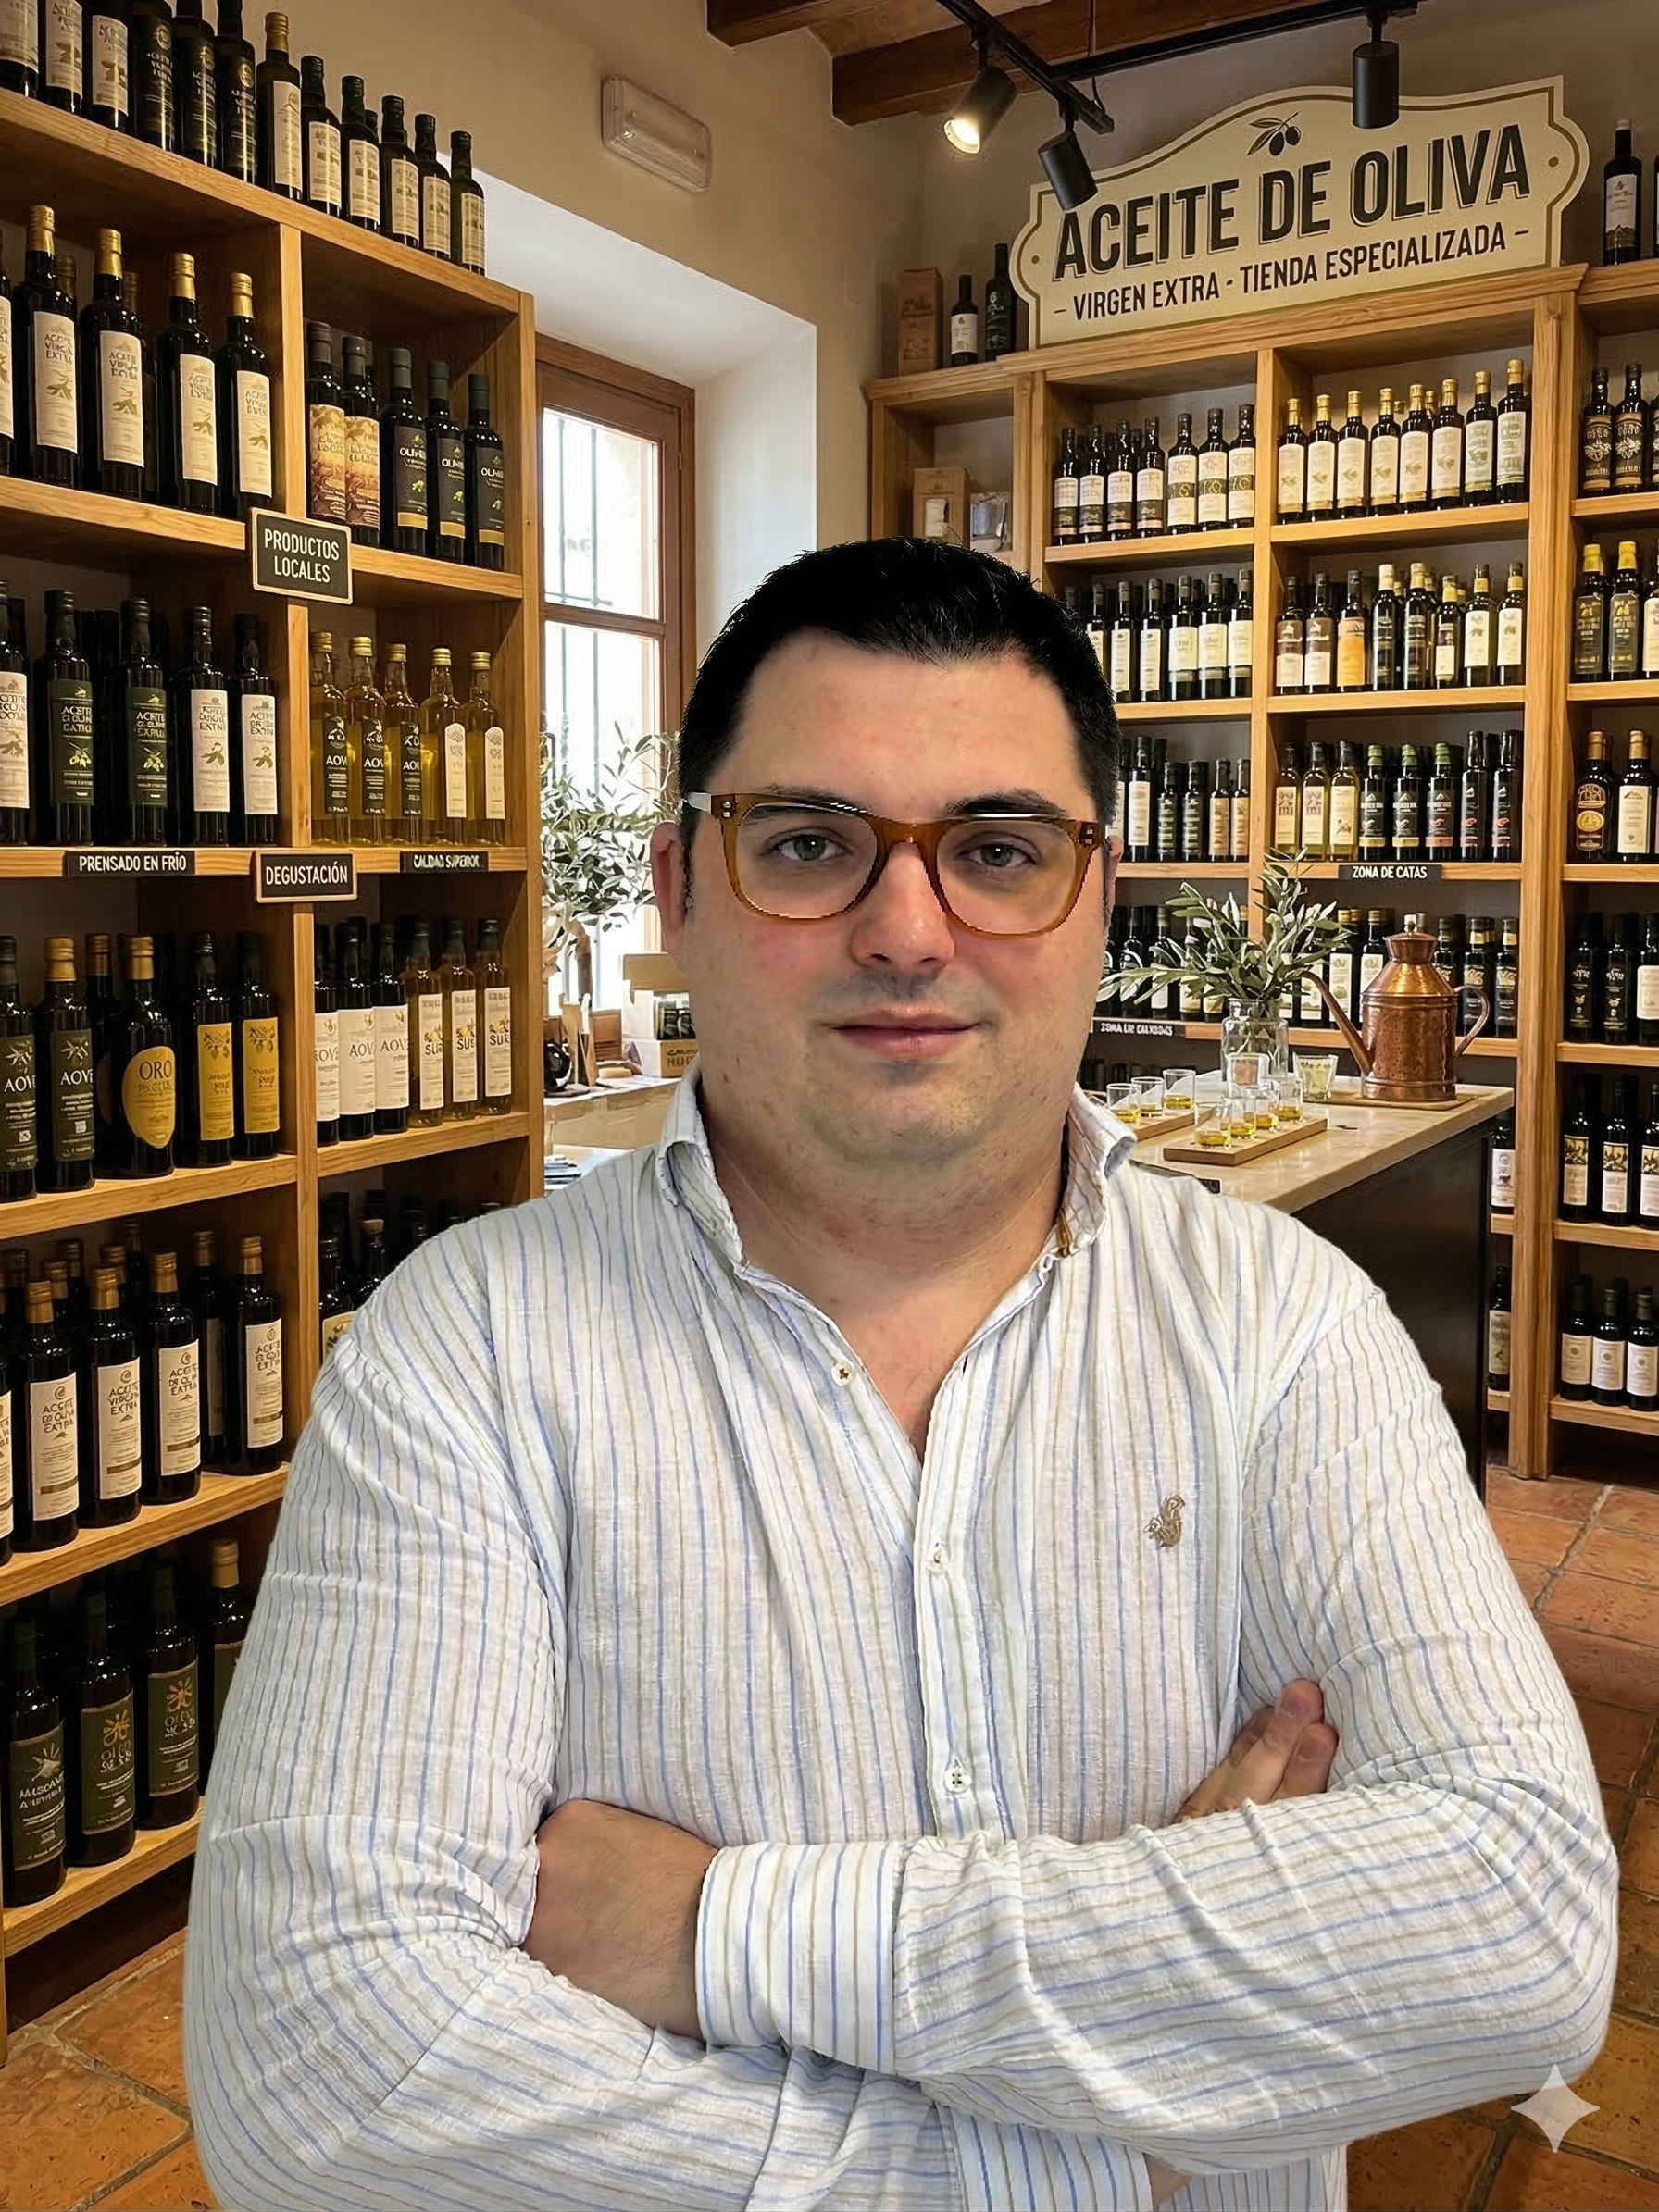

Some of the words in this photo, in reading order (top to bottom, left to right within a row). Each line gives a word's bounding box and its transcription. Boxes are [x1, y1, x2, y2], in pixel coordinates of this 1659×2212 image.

[1053, 179, 1240, 281] ACEITE
[1258, 161, 1331, 244] DE
[1350, 124, 1531, 227] OLIVA
[1073, 283, 1146, 320] VIRGEN
[1152, 271, 1220, 308] EXTRA
[1240, 255, 1318, 293] TIENDA
[1326, 222, 1506, 280] ESPECIALIZADA
[264, 528, 340, 561] PRODUCTOS
[274, 555, 331, 583] LOCALES
[80, 855, 141, 872] PRENSADO
[144, 855, 159, 871] EN
[266, 861, 348, 886] DEGUSTACIÓN
[1352, 865, 1379, 878] ZONA
[1380, 865, 1394, 878] DE
[1396, 865, 1428, 879] CATAS
[139, 1060, 173, 1081] ORO
